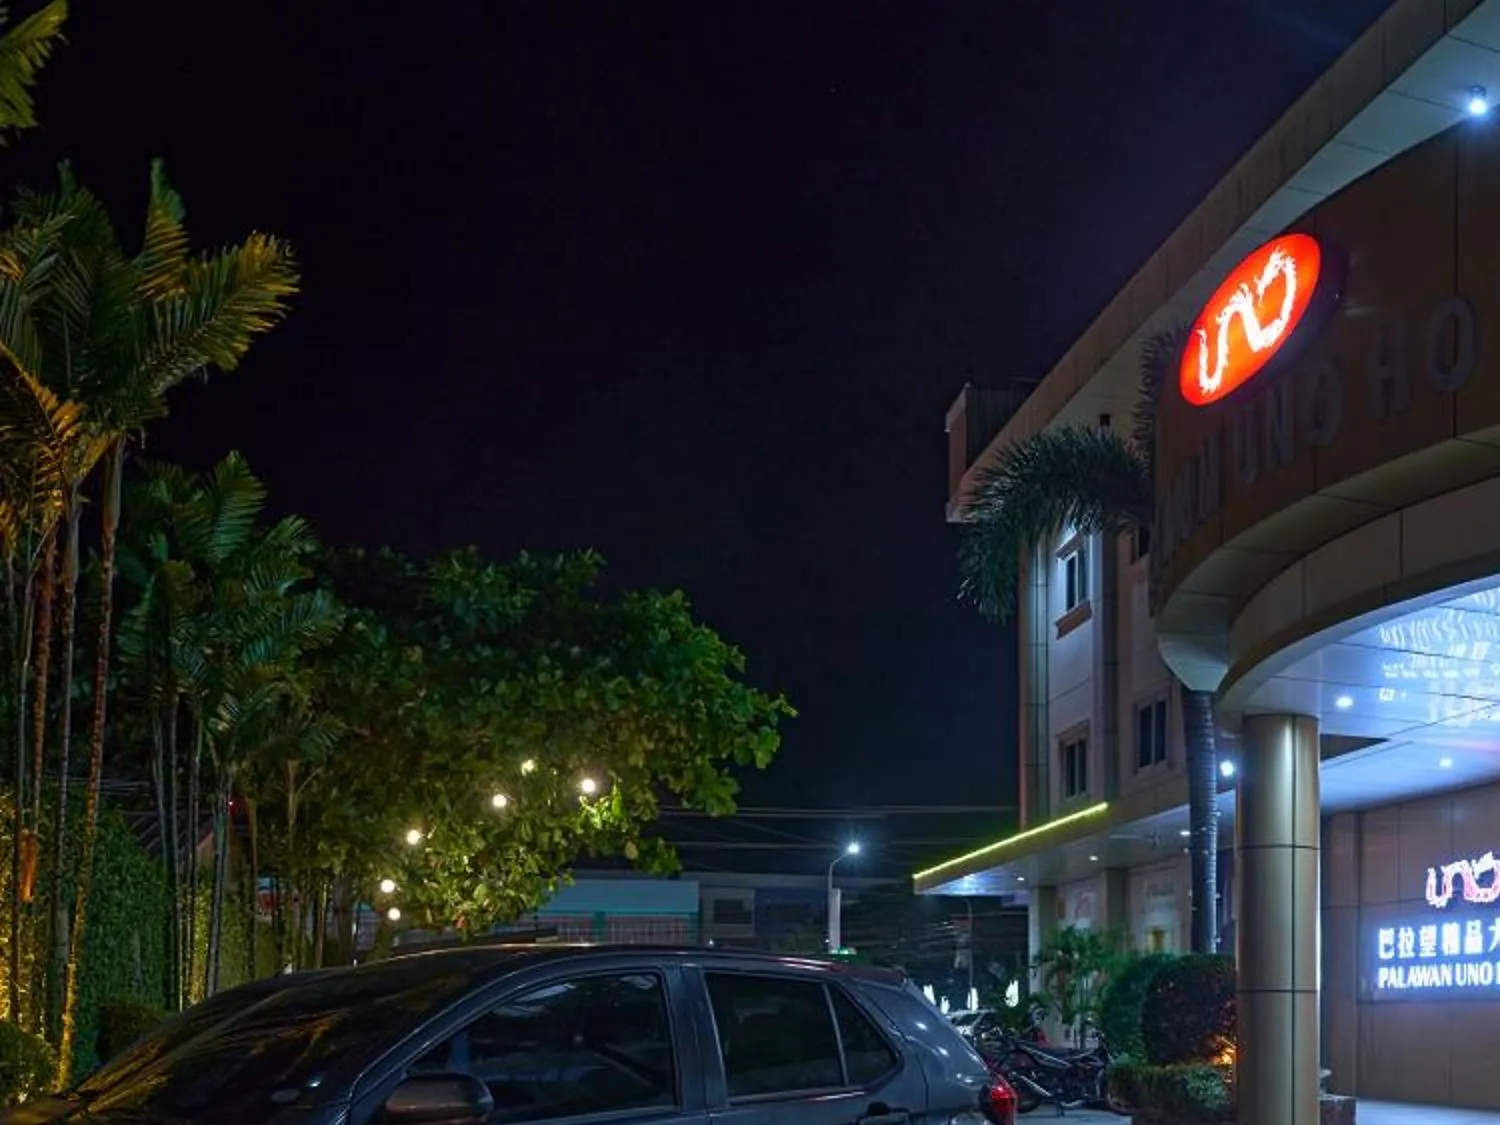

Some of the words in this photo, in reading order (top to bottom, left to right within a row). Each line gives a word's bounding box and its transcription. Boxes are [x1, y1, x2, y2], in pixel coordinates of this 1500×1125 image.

[1232, 358, 1344, 484] UNO
[1378, 964, 1453, 989] PALAWAN
[1455, 961, 1493, 987] UNO
